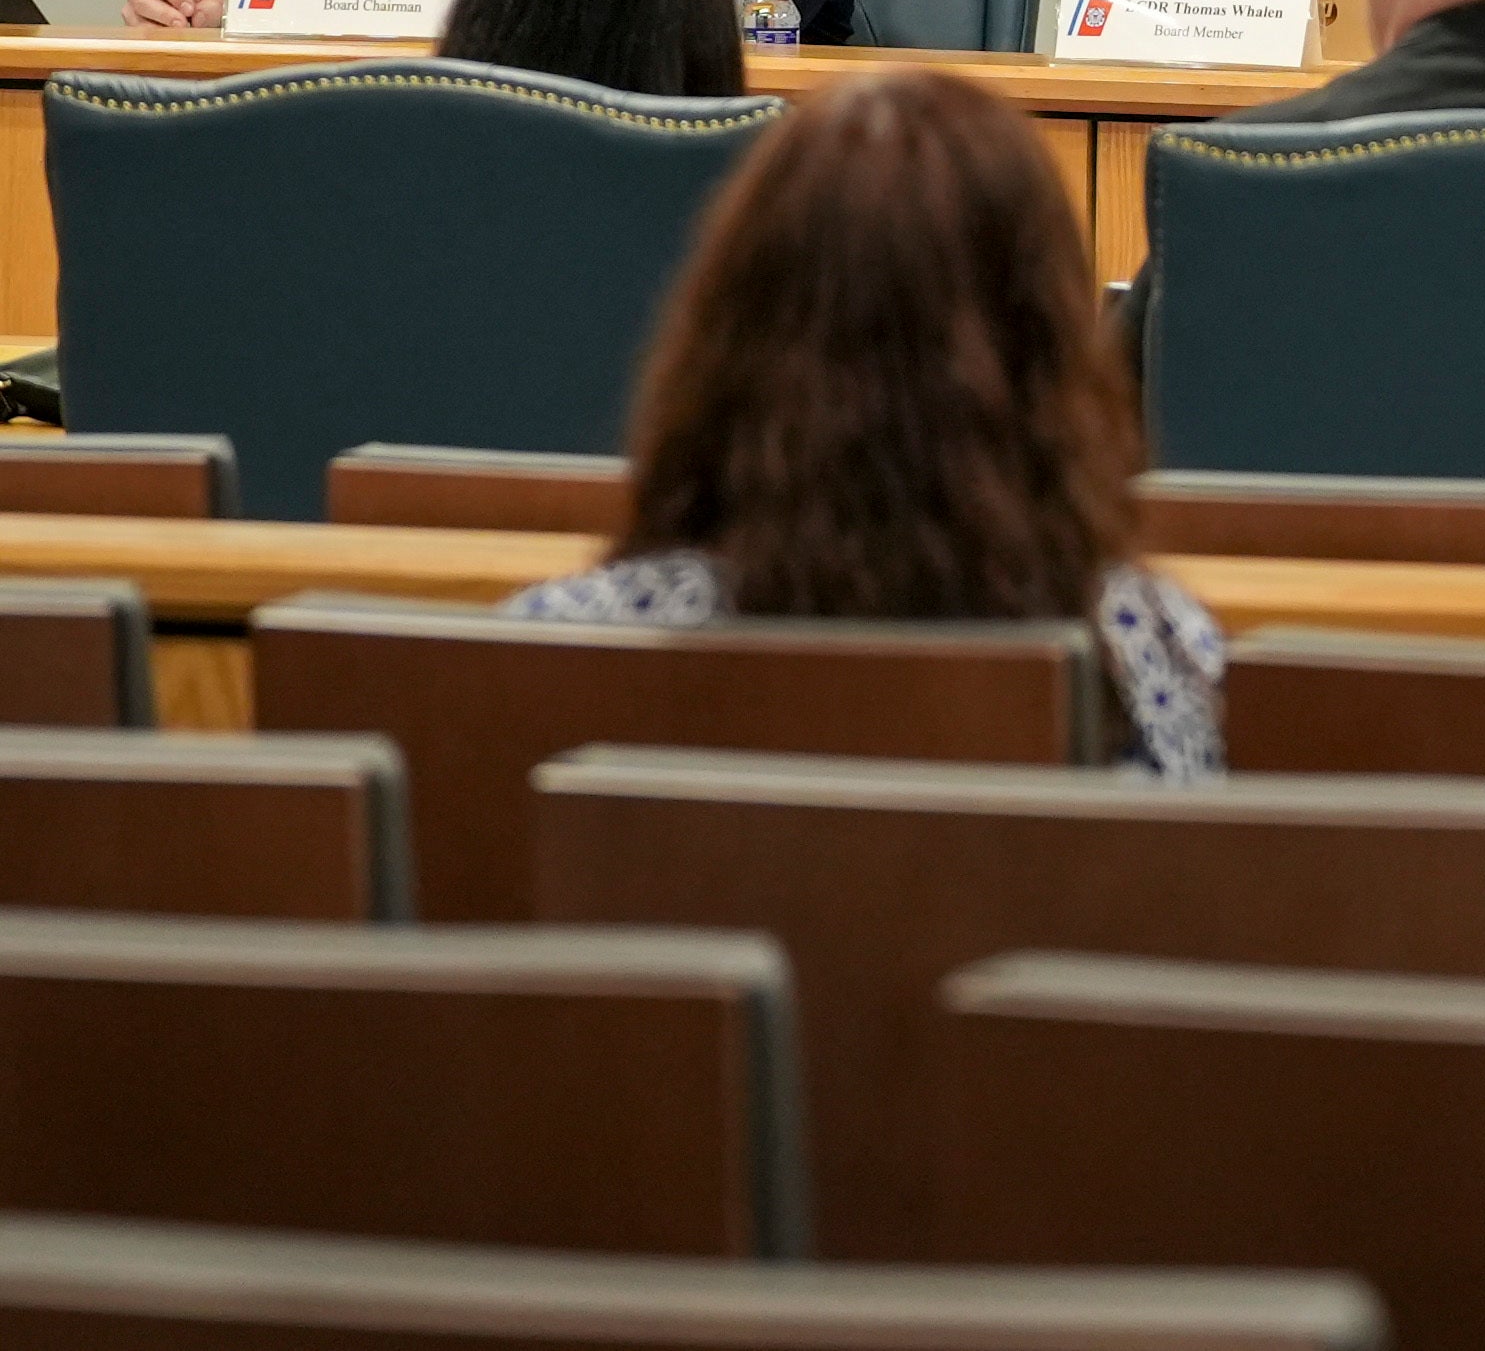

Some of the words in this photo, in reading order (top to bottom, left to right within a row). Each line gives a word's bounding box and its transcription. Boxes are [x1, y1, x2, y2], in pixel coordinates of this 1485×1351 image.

[323, 0, 360, 11] Board
[363, 0, 422, 13] Chairman
[1174, 1, 1227, 16] Thomas
[1232, 3, 1283, 19] Whalen
[1154, 24, 1190, 38] Board
[1193, 25, 1244, 40] Member
